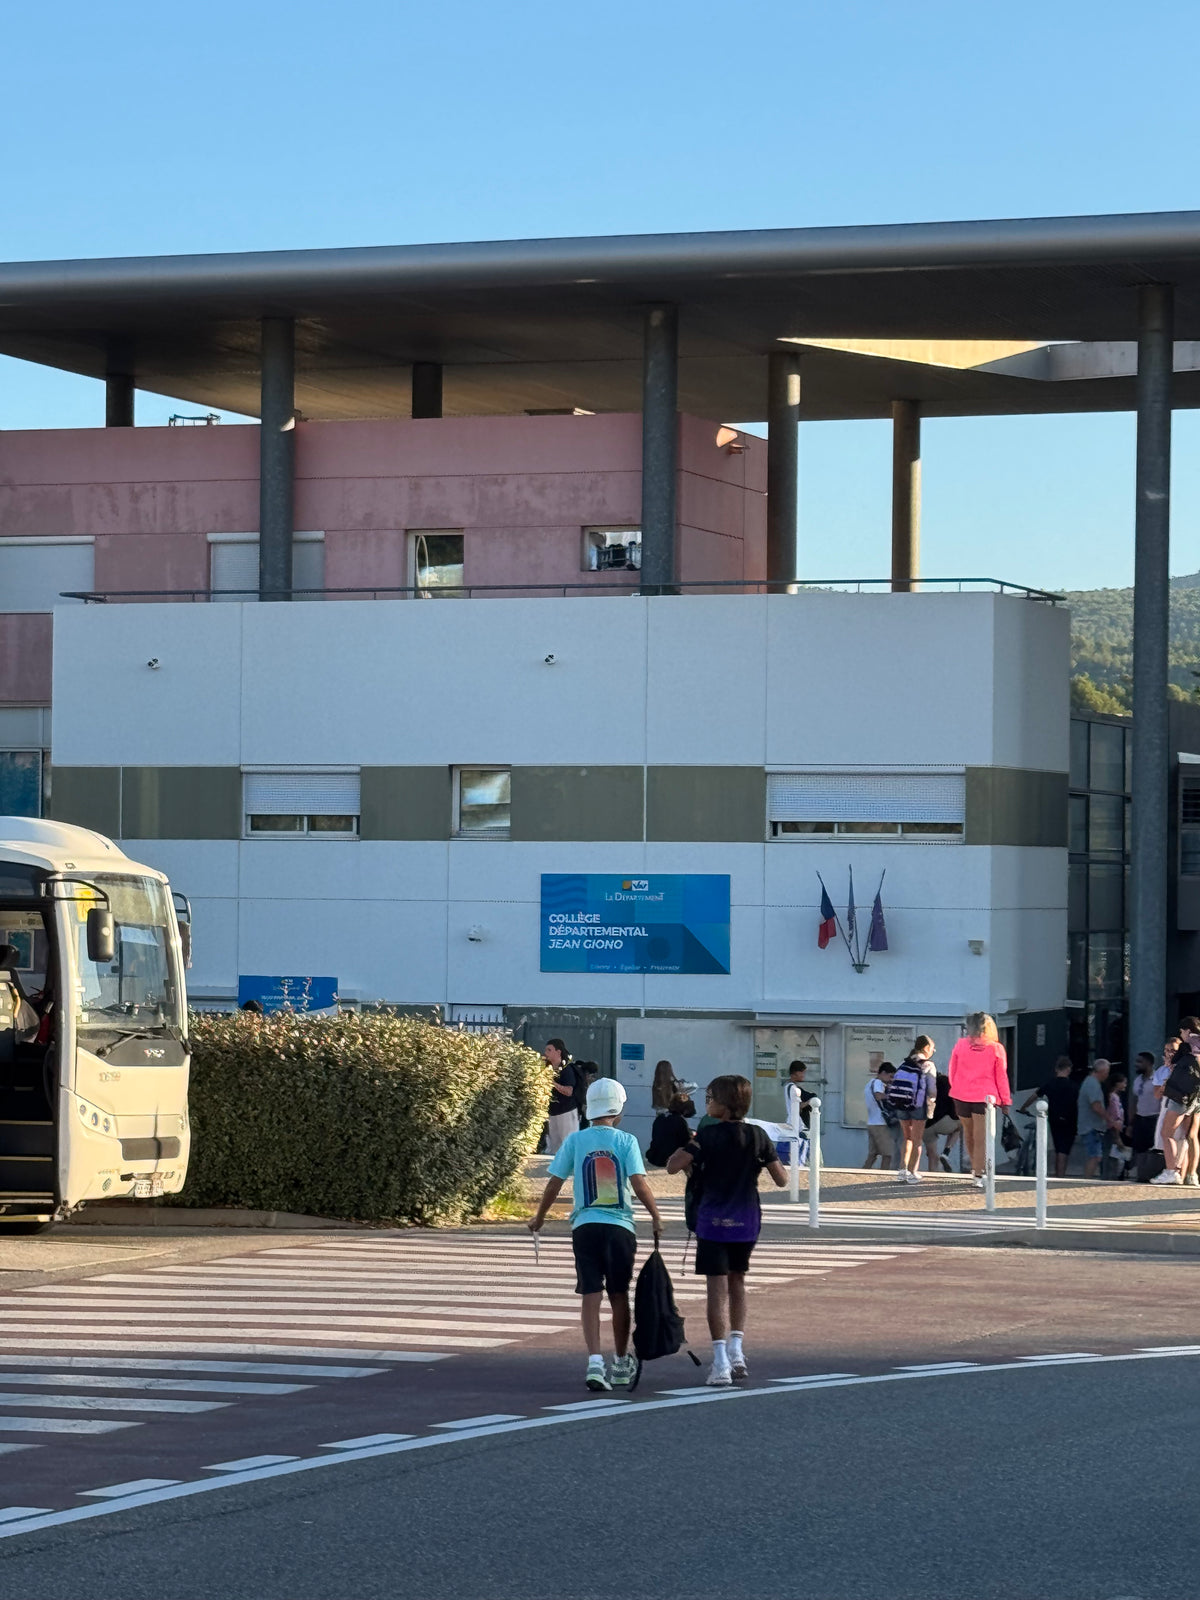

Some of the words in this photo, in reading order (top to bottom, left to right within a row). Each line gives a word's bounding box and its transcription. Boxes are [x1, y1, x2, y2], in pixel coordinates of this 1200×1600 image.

[549, 912, 600, 924] COLLÈGE
[549, 924, 648, 937] DÉPARTEMENTAL
[548, 939, 580, 950] JEAN
[583, 939, 623, 950] GIONO
